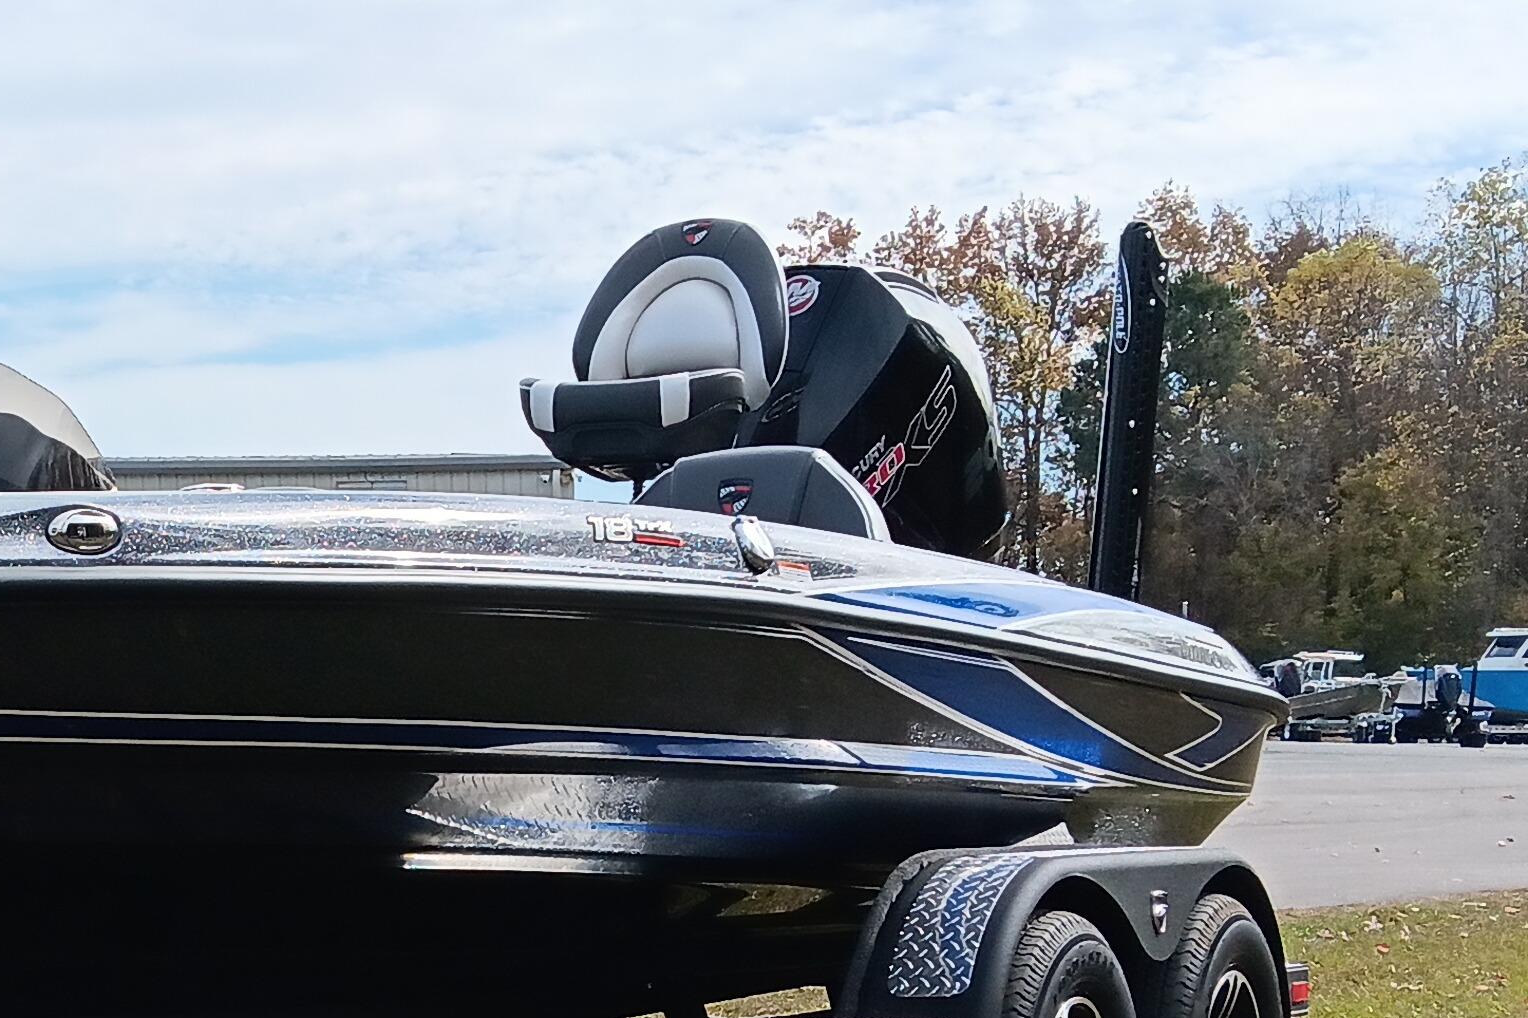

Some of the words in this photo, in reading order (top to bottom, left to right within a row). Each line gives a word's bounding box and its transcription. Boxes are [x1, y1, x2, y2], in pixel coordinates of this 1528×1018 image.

[852, 435, 886, 478] CURY
[882, 364, 958, 509] XS
[862, 442, 906, 497] RO
[586, 516, 633, 543] 18
